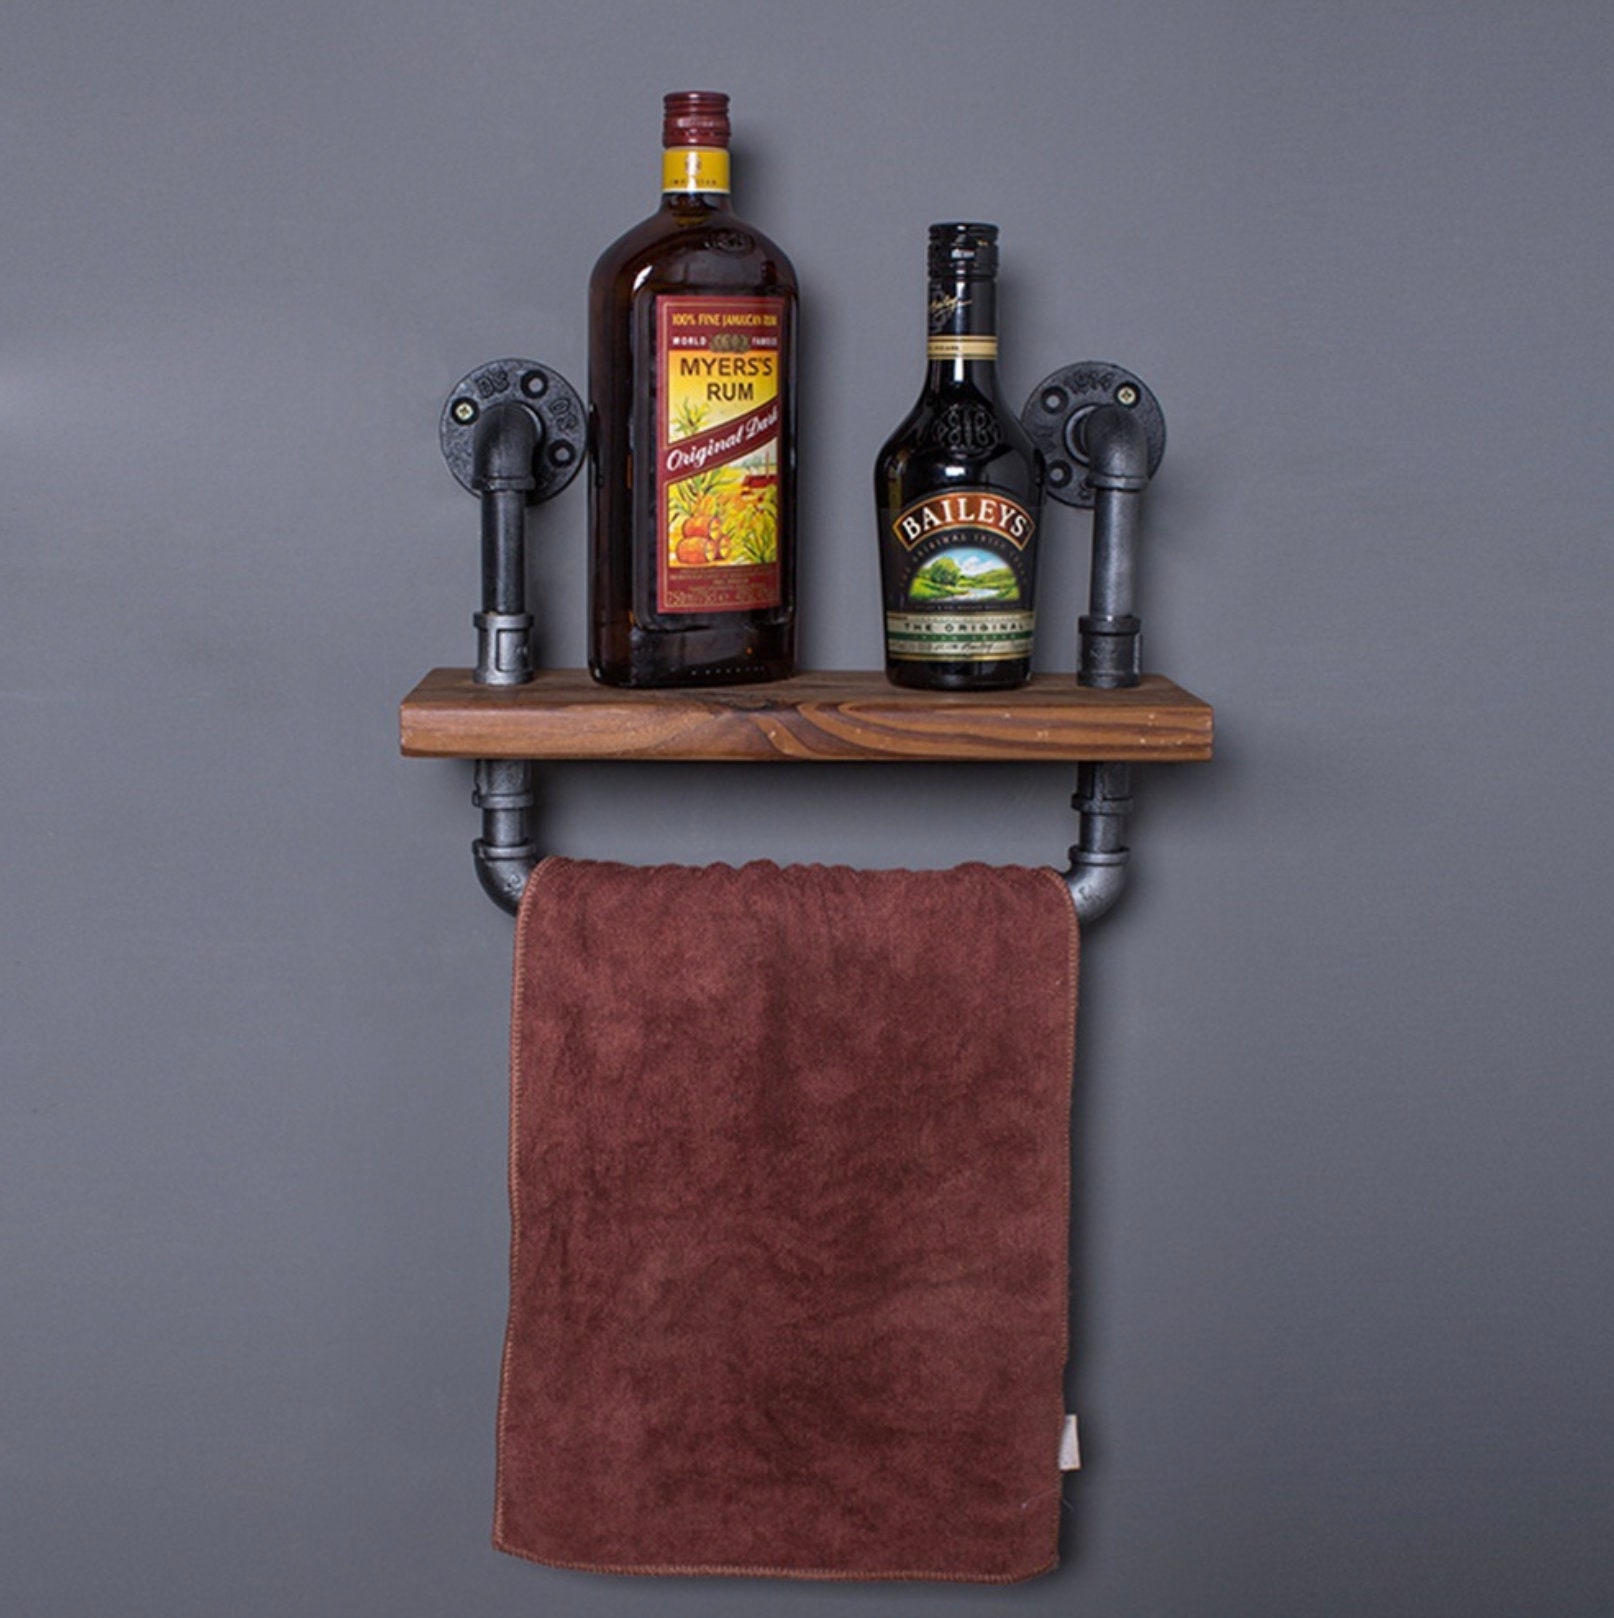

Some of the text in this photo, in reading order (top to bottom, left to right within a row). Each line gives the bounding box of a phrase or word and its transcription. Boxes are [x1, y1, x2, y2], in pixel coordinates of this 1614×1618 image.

[672, 313, 696, 326] 100%
[698, 313, 720, 326] FINE
[672, 336, 707, 346] WORLD
[680, 357, 773, 377] MYERS'S
[707, 382, 754, 401] RUM
[666, 423, 745, 472] Original
[902, 497, 1028, 541] BAILEYS
[904, 621, 1025, 633] THE ORIGINAL
